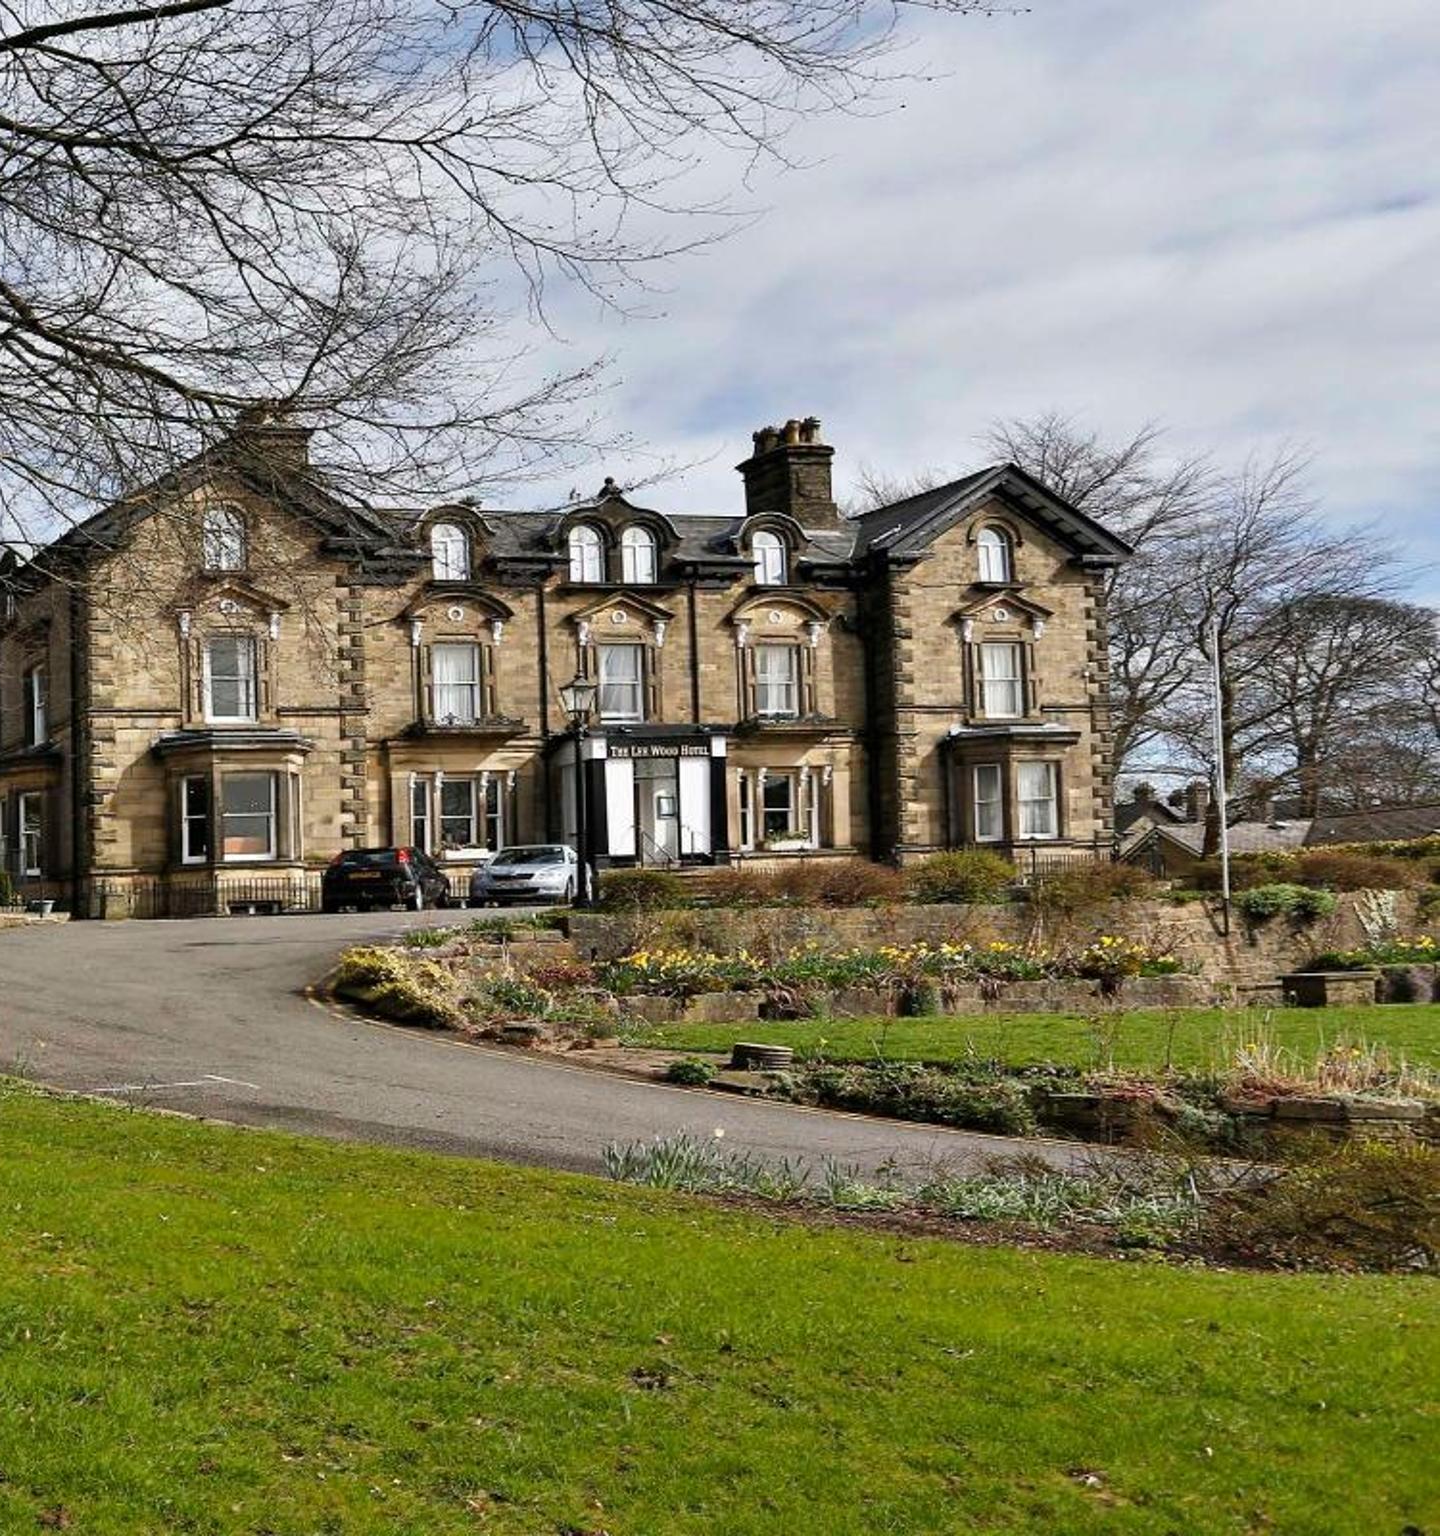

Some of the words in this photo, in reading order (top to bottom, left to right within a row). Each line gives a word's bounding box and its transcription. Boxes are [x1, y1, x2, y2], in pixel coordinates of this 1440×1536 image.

[610, 746, 629, 757] THE
[651, 745, 678, 756] WOOD
[681, 744, 710, 756] HOTEL
